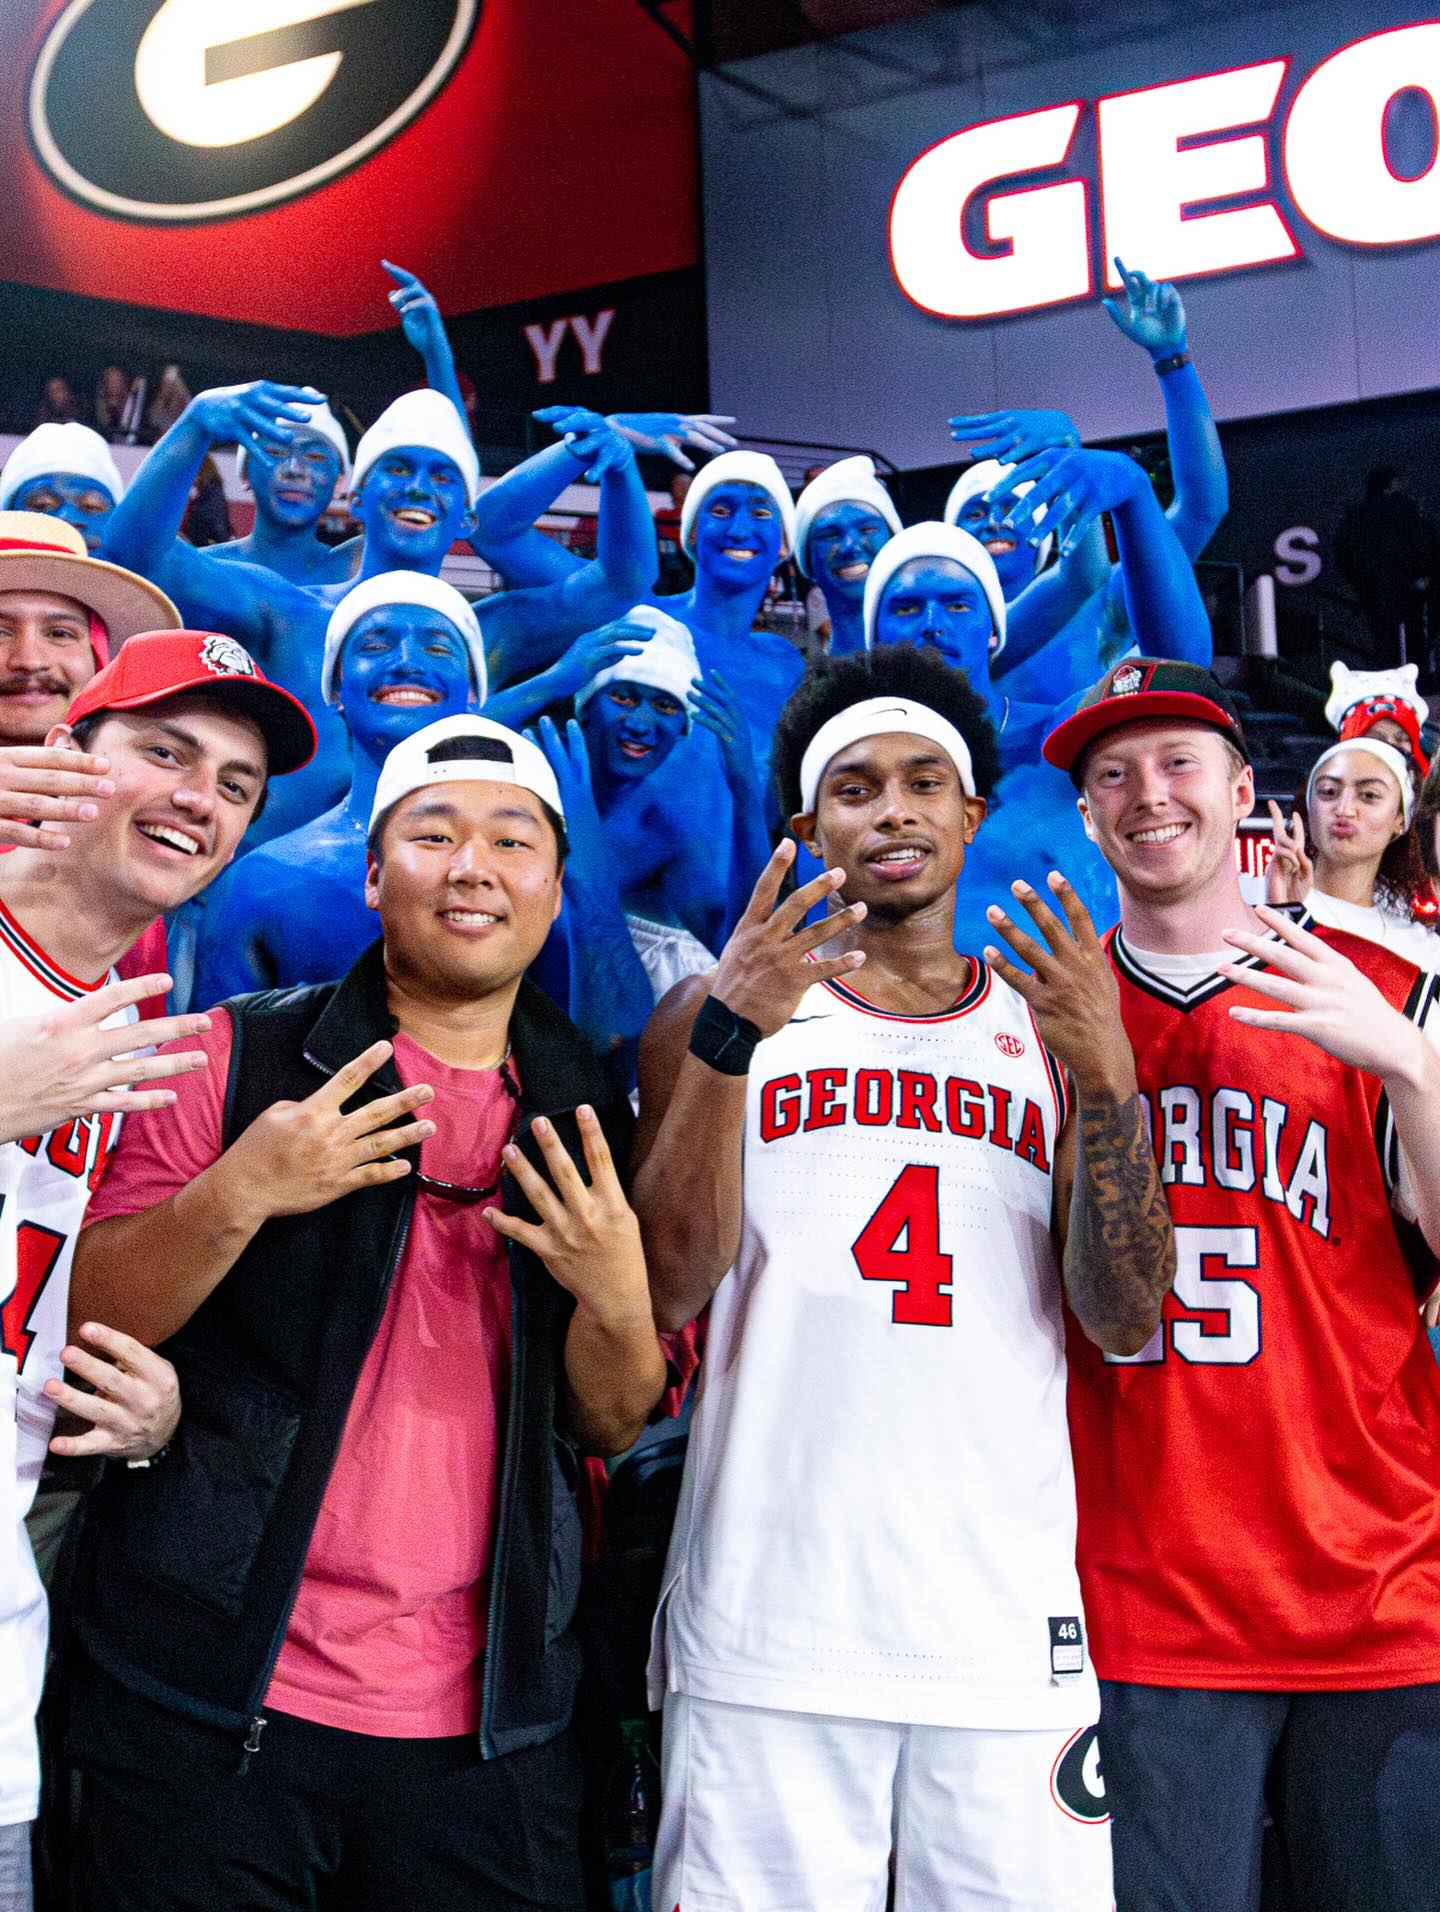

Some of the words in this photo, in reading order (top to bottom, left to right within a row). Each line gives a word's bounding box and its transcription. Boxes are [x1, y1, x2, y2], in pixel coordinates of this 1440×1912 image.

[887, 18, 1440, 321] GEO
[524, 309, 616, 384] YY
[1274, 525, 1322, 586] S
[997, 1034, 1022, 1055] SEC
[760, 1067, 1051, 1175] GEORGIA
[1137, 1084, 1331, 1241] RGIA
[851, 1163, 953, 1328] 4
[1058, 1622, 1077, 1640] 46
